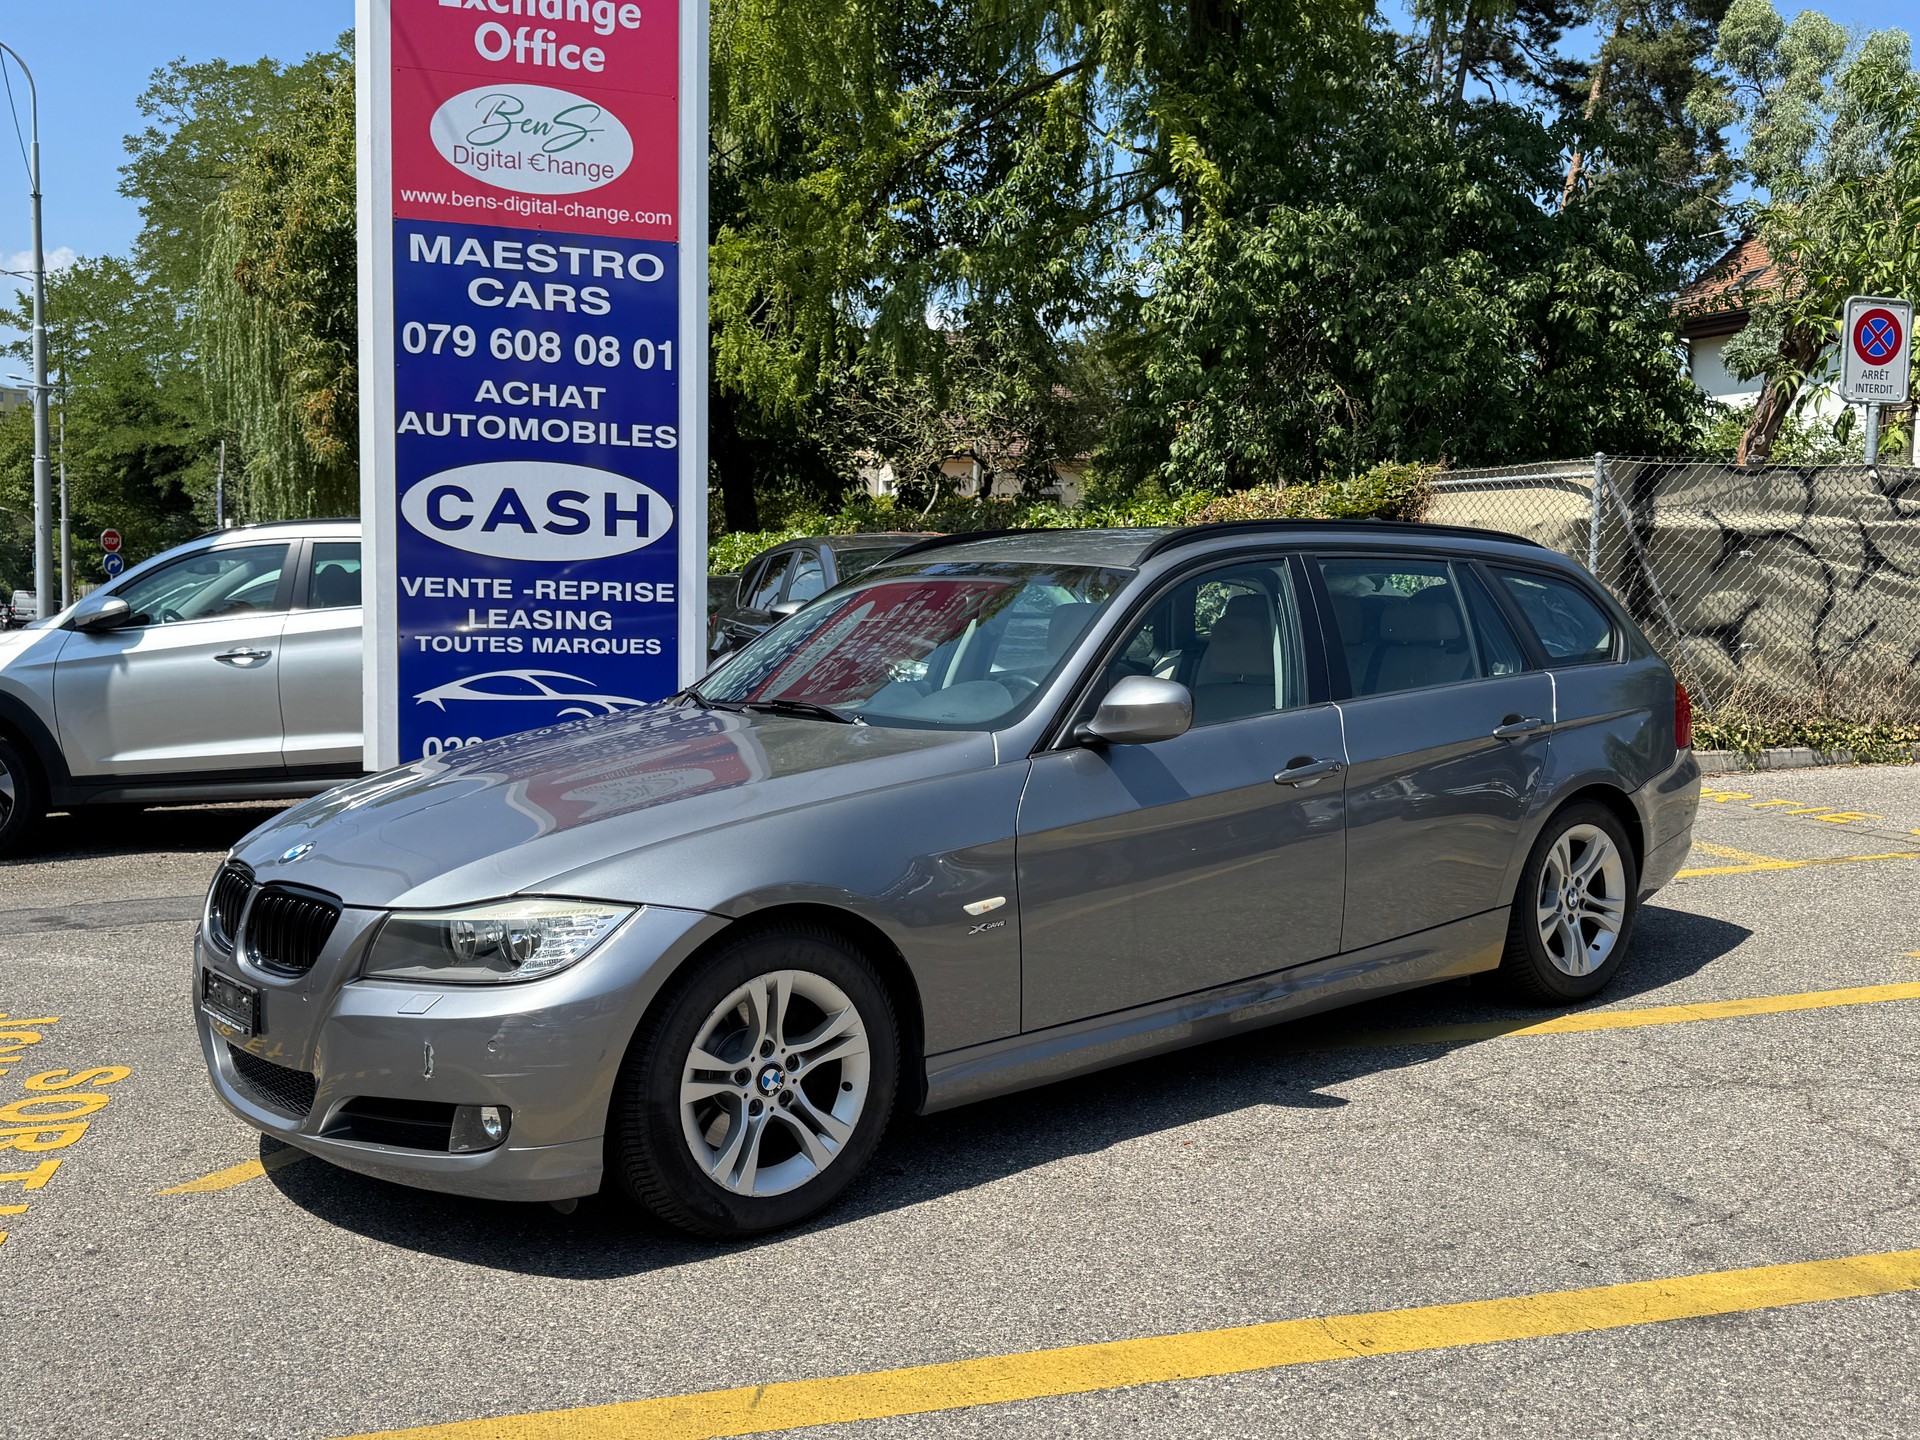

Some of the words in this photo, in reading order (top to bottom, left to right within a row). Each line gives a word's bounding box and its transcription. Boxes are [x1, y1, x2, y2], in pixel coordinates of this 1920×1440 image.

[438, 0, 643, 36] cange
[474, 21, 606, 73] Office
[453, 145, 522, 171] Digital
[527, 153, 614, 182] €hange
[400, 189, 673, 226] www.bens-digital-change.com
[409, 233, 664, 282] MAESTRO
[468, 277, 611, 315] CARS
[402, 321, 476, 357] 079
[490, 327, 562, 363] 608
[574, 334, 621, 367] 08
[633, 338, 672, 371] 01
[1855, 383, 1894, 395] INTERDIT
[1861, 369, 1890, 381] ARRÊT
[474, 380, 607, 410] ACHAT
[397, 411, 677, 449] AUTOMOBILES
[426, 484, 650, 539] CASH
[104, 537, 119, 545] STOP
[400, 576, 513, 599] VENTE
[468, 608, 612, 631] LEASING
[414, 635, 524, 653] TOUTES
[532, 637, 662, 656] MARQUES
